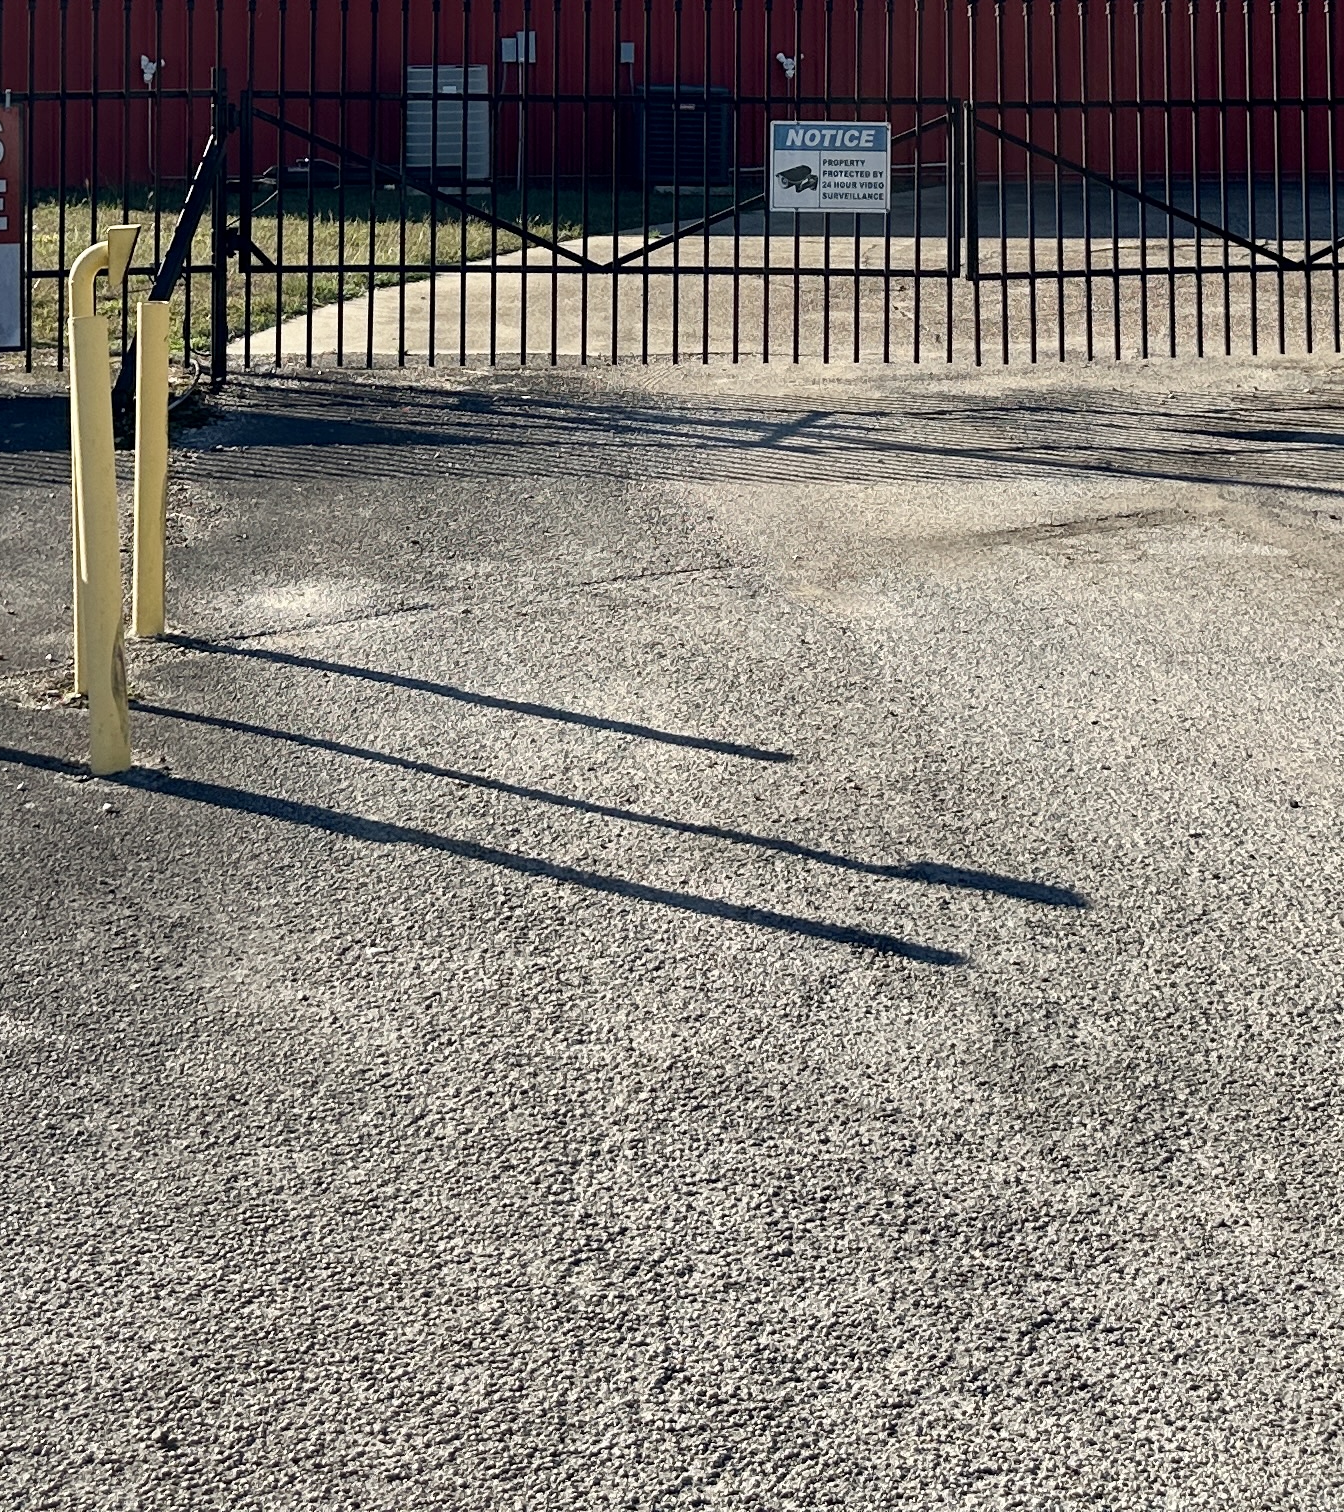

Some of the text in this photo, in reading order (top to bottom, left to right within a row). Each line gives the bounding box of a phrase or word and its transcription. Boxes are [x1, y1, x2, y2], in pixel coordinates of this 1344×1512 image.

[785, 128, 876, 148] NOTICE
[822, 158, 866, 167] PROPERTY
[822, 170, 884, 178] PROTECTED BY
[821, 181, 885, 189] 24 HOUR VIDEO
[822, 192, 885, 201] SURVEILLANCE
